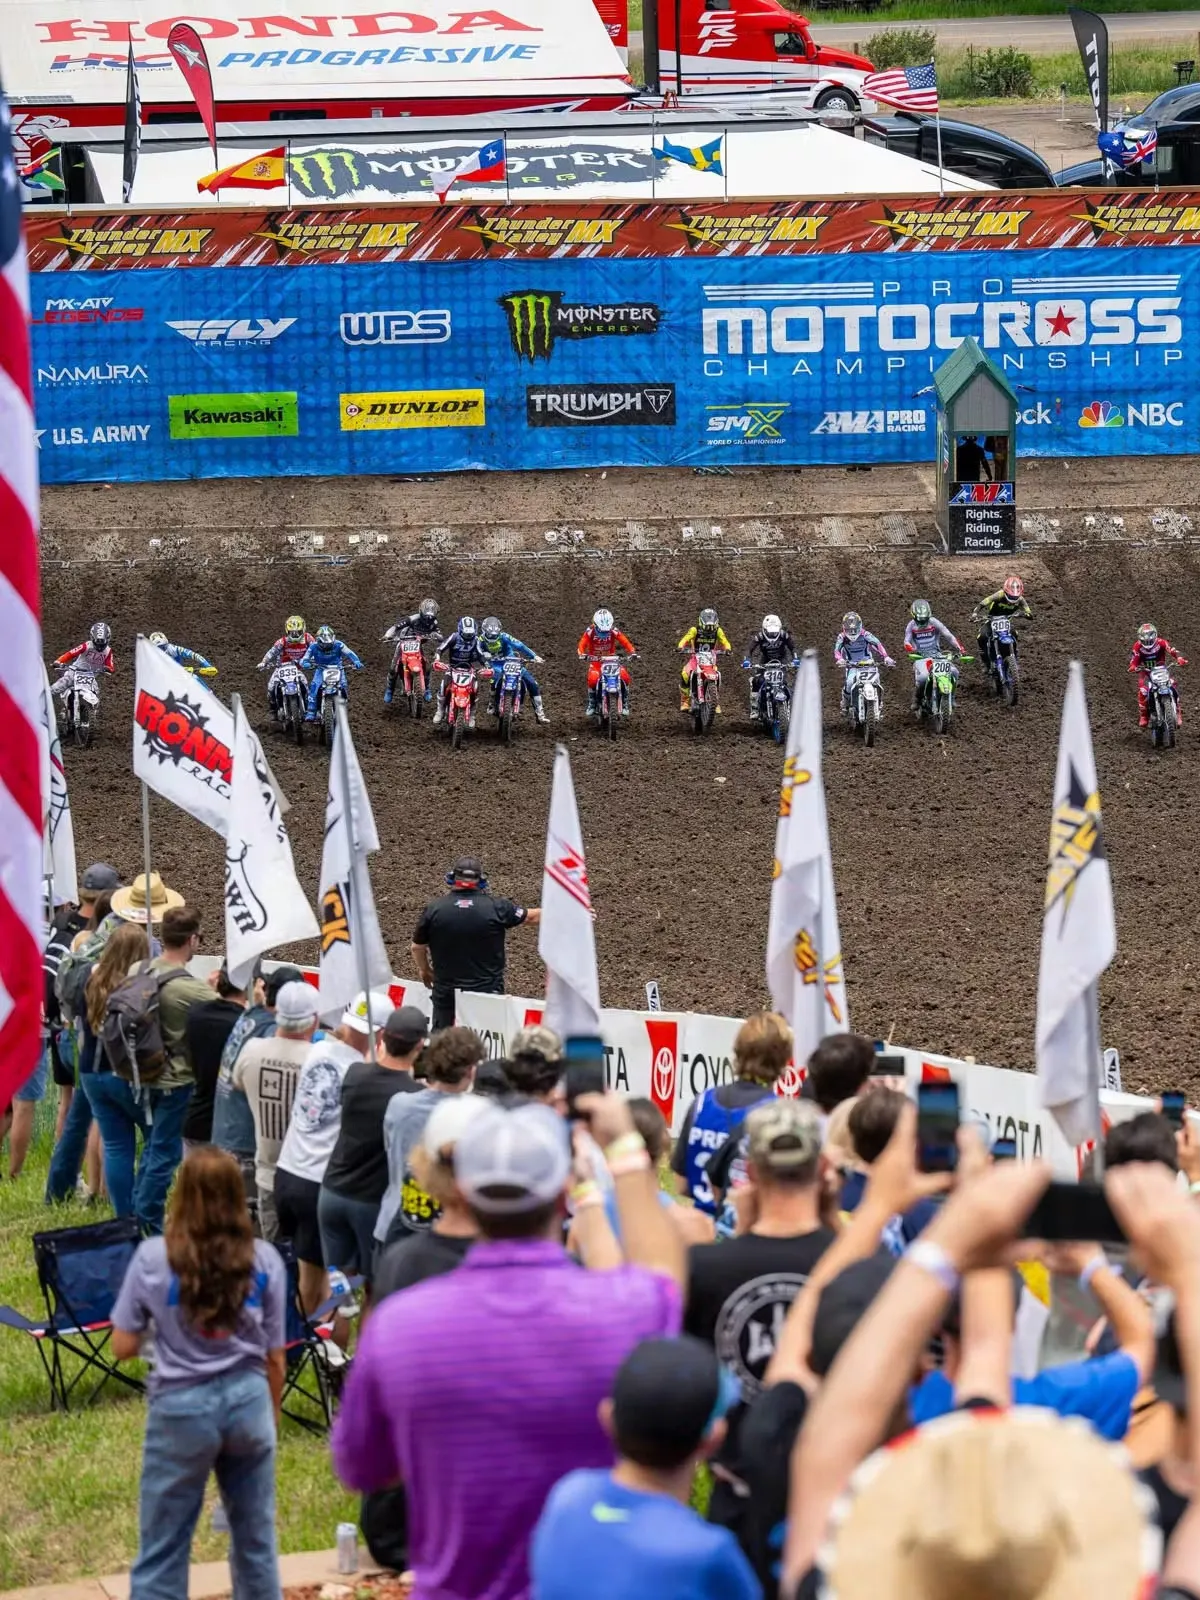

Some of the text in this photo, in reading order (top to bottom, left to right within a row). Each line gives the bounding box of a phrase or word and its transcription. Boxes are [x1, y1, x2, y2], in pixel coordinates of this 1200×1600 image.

[35, 10, 544, 43] HONDA
[218, 44, 542, 69] PROGRESSIVE
[893, 209, 983, 224] Thunder
[1095, 205, 1182, 220] Thunder
[276, 222, 369, 237] Thunder
[484, 216, 575, 231] Thunder
[689, 214, 783, 230] Thunder
[703, 217, 826, 244] Valley MX
[906, 211, 1030, 239] Valley MX
[1106, 218, 1172, 233] Valley
[69, 227, 163, 242] Thunder
[290, 223, 418, 250] Valley MX
[498, 219, 623, 245] Valley MX
[83, 229, 210, 257] Valley MX
[883, 279, 1004, 298] PRO
[556, 306, 657, 323] MONSTER
[165, 318, 299, 342] FLY
[340, 310, 451, 345] WPS
[571, 325, 641, 333] ENERGY
[702, 297, 1182, 355] MOTOCROSS
[38, 361, 148, 383] NAMURA
[704, 350, 1183, 377] CHAMPINSHIP
[367, 400, 479, 416] DUNLOP
[531, 392, 642, 420] TRIUMPH
[1127, 402, 1183, 426] NBC
[184, 407, 284, 425] Kawasaki
[706, 410, 784, 437] SMX
[810, 410, 926, 434] AMA PRO
[53, 424, 150, 446] U.S. ARMY
[887, 424, 926, 433] RACING
[949, 483, 1016, 506] AMA
[965, 509, 1003, 520] Rights.
[965, 523, 1003, 534] Riding.
[964, 537, 1004, 548] Racing.
[326, 670, 340, 681] 2
[603, 664, 621, 675] 97
[859, 671, 877, 682] 27
[456, 674, 470, 684] 17
